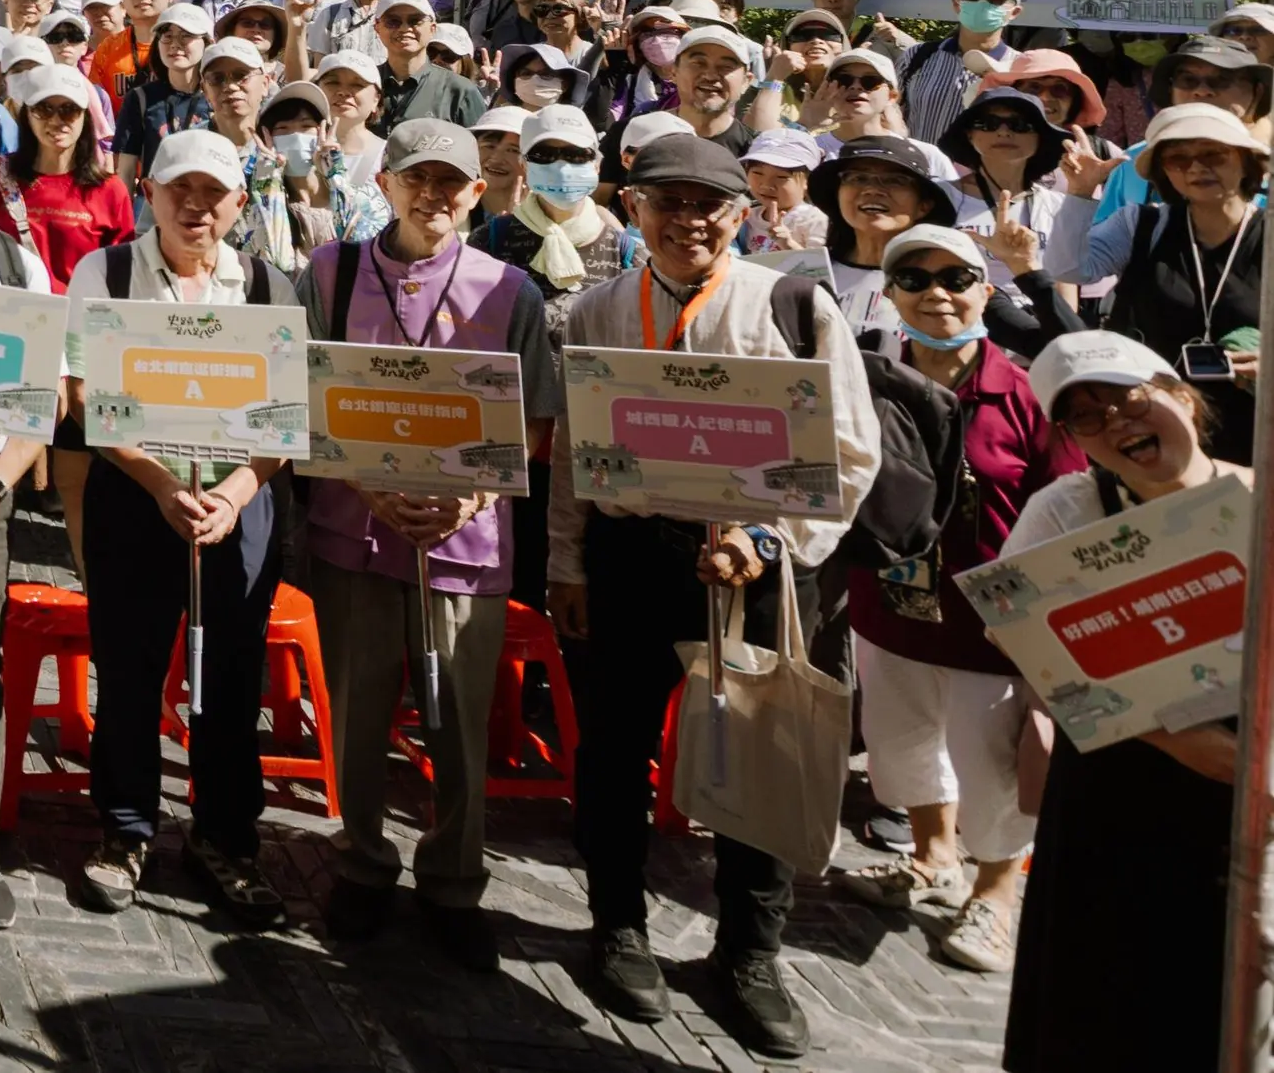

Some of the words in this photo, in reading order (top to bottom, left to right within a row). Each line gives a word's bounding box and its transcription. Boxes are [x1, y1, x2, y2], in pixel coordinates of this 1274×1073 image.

[184, 380, 204, 400] A
[393, 419, 411, 437] C
[625, 411, 774, 435] 城西職人記憶走讀
[689, 435, 711, 455] A
[1151, 615, 1186, 645] B
